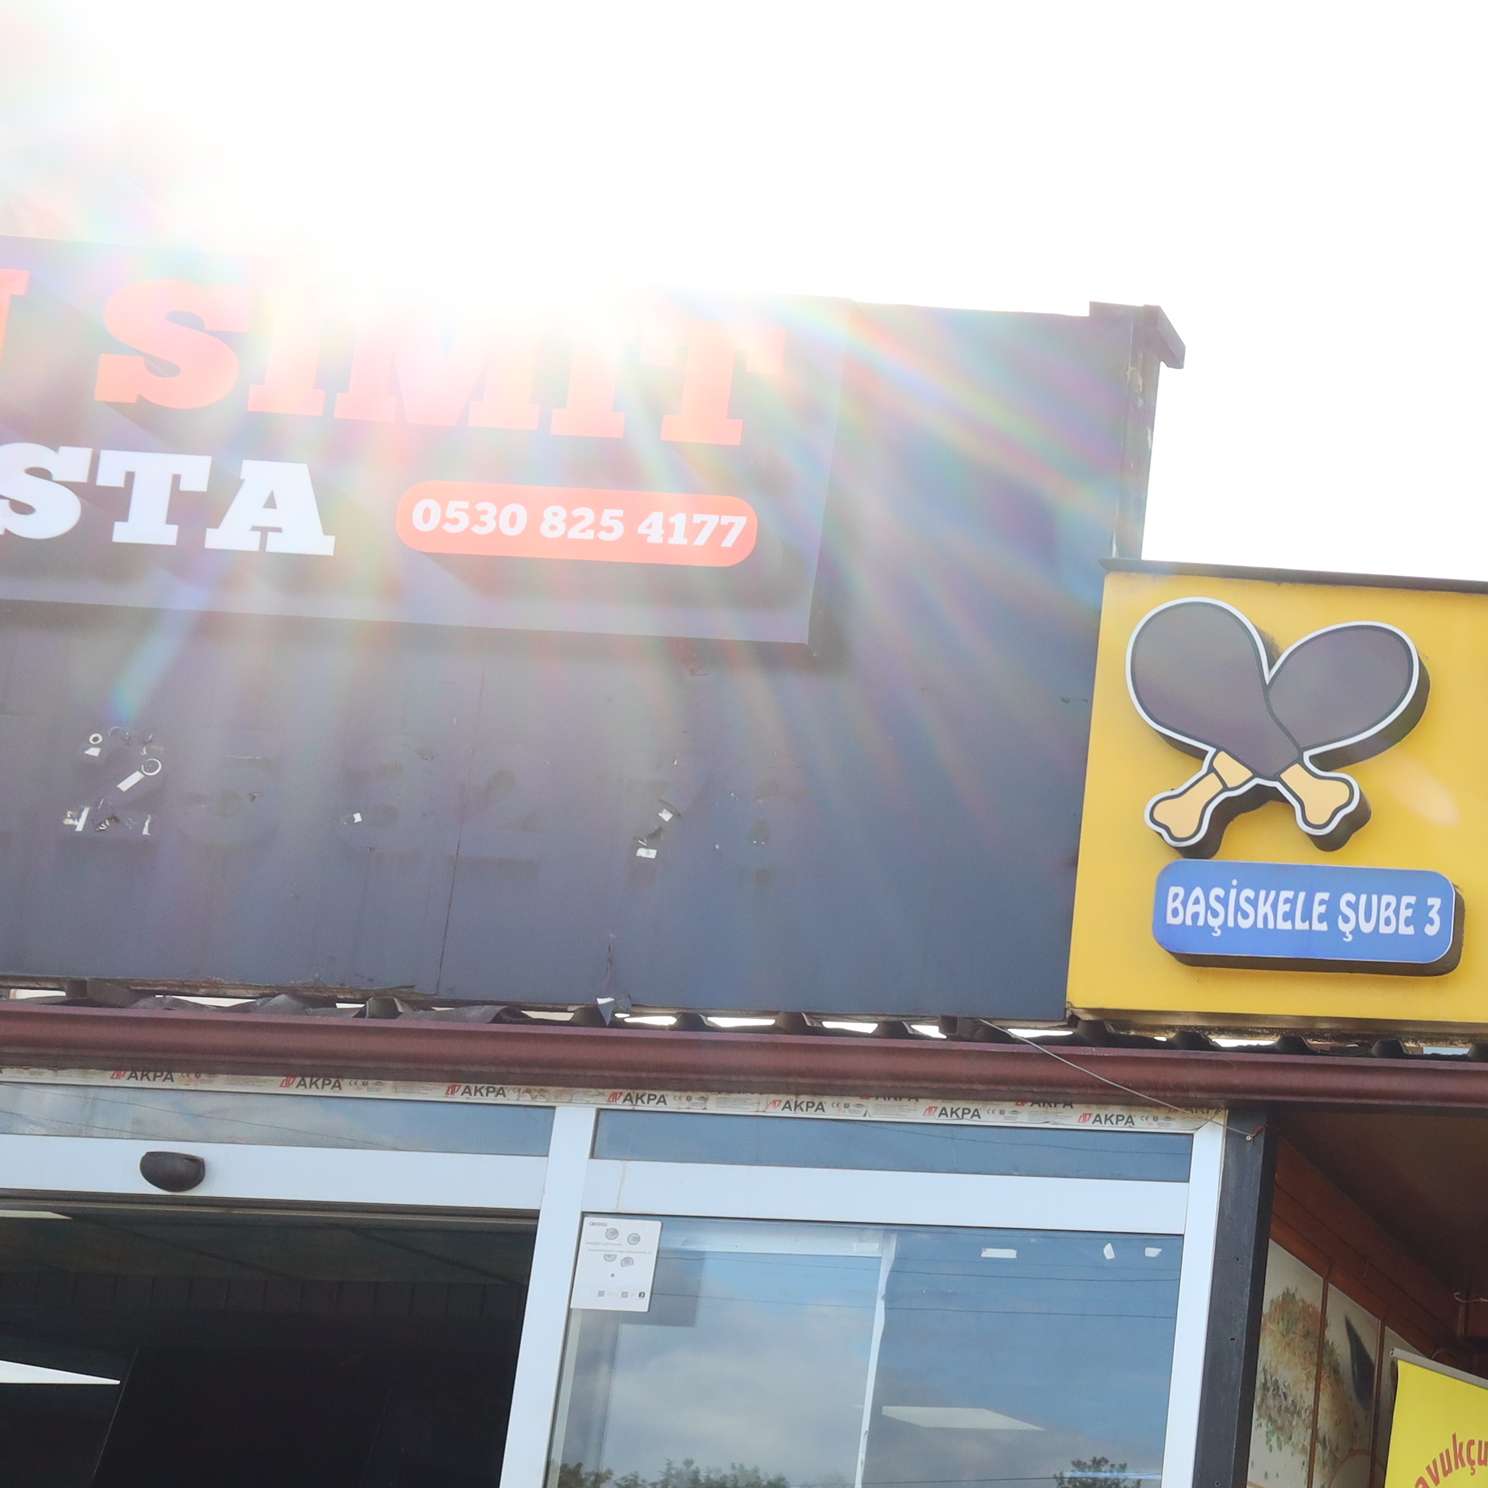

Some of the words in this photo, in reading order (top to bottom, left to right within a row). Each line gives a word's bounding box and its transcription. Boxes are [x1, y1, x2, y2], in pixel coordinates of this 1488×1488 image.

[411, 498, 527, 537] 0530
[540, 505, 625, 543] 825
[637, 511, 748, 550] 4177
[1166, 879, 1329, 937] BAŞİSKELE
[1338, 891, 1416, 941] ŞUBE
[1425, 897, 1442, 936] 3
[295, 1076, 343, 1091] AKPA
[460, 1084, 507, 1098] AKPA
[622, 1092, 668, 1106] AKPA
[780, 1099, 826, 1113] AKPA
[937, 1106, 982, 1120] AKPA
[1091, 1113, 1136, 1126] AKPA
